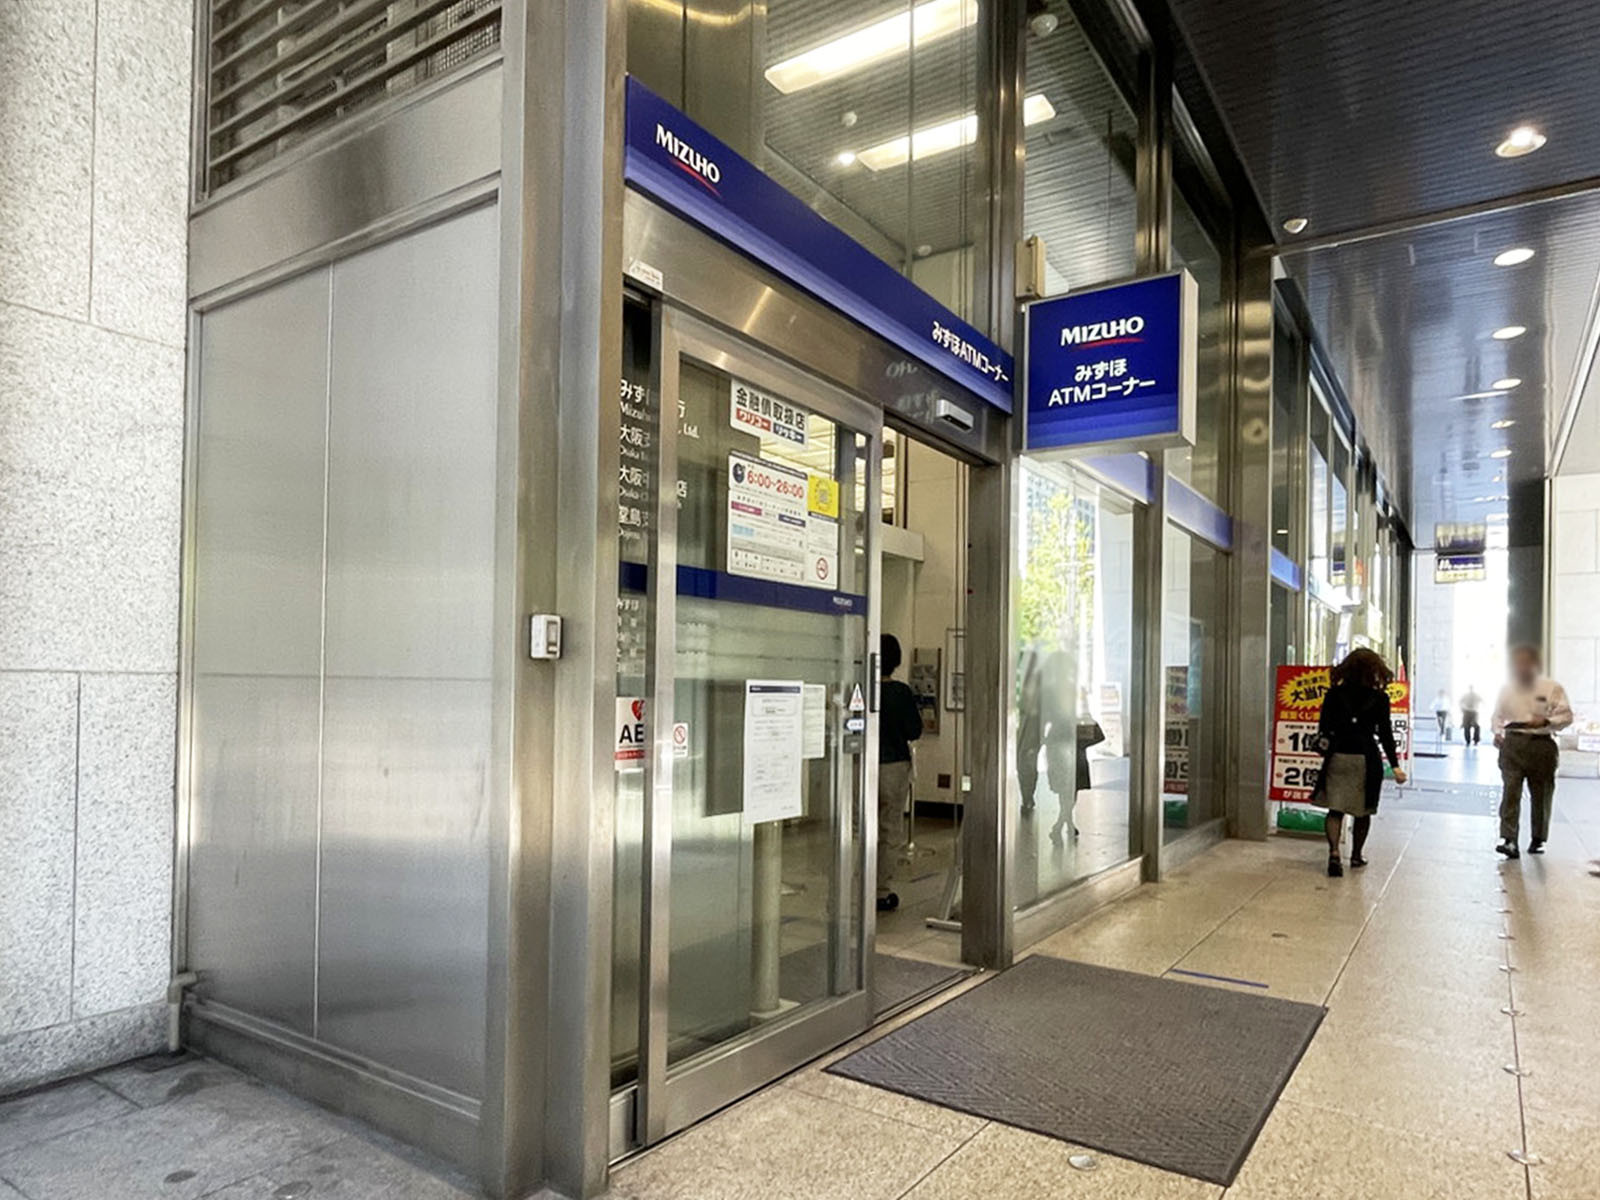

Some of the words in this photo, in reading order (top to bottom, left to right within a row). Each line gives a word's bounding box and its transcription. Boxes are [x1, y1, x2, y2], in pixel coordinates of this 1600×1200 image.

[656, 123, 720, 183] MIZUHO
[1061, 316, 1144, 346] MIZUHO
[931, 320, 1010, 382] みずほATMコーナー
[1074, 358, 1128, 382] みずほ
[1048, 376, 1156, 407] ATMコーナー
[619, 723, 645, 743] AE
